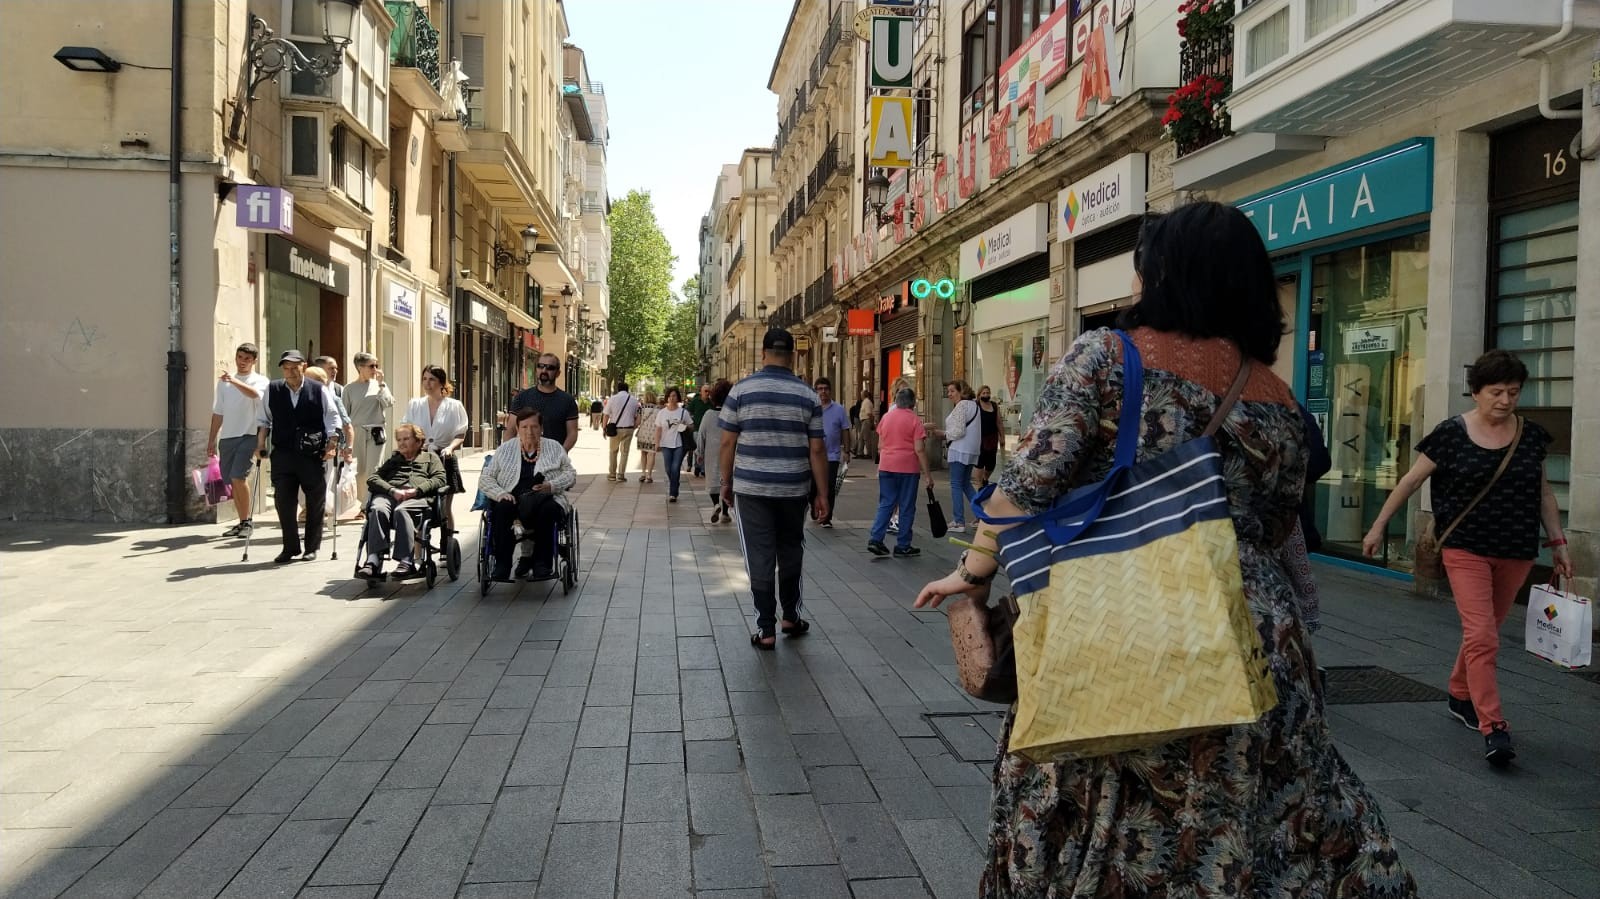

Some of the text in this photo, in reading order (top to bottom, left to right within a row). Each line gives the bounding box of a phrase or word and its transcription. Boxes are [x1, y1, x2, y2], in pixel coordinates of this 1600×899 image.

[1543, 149, 1567, 178] 16
[246, 191, 270, 223] fi
[1081, 173, 1120, 212] Medical
[1245, 172, 1376, 241] LAIA
[988, 227, 1011, 254] Medical
[289, 246, 335, 288] finetwork
[1536, 618, 1562, 635] Medical
